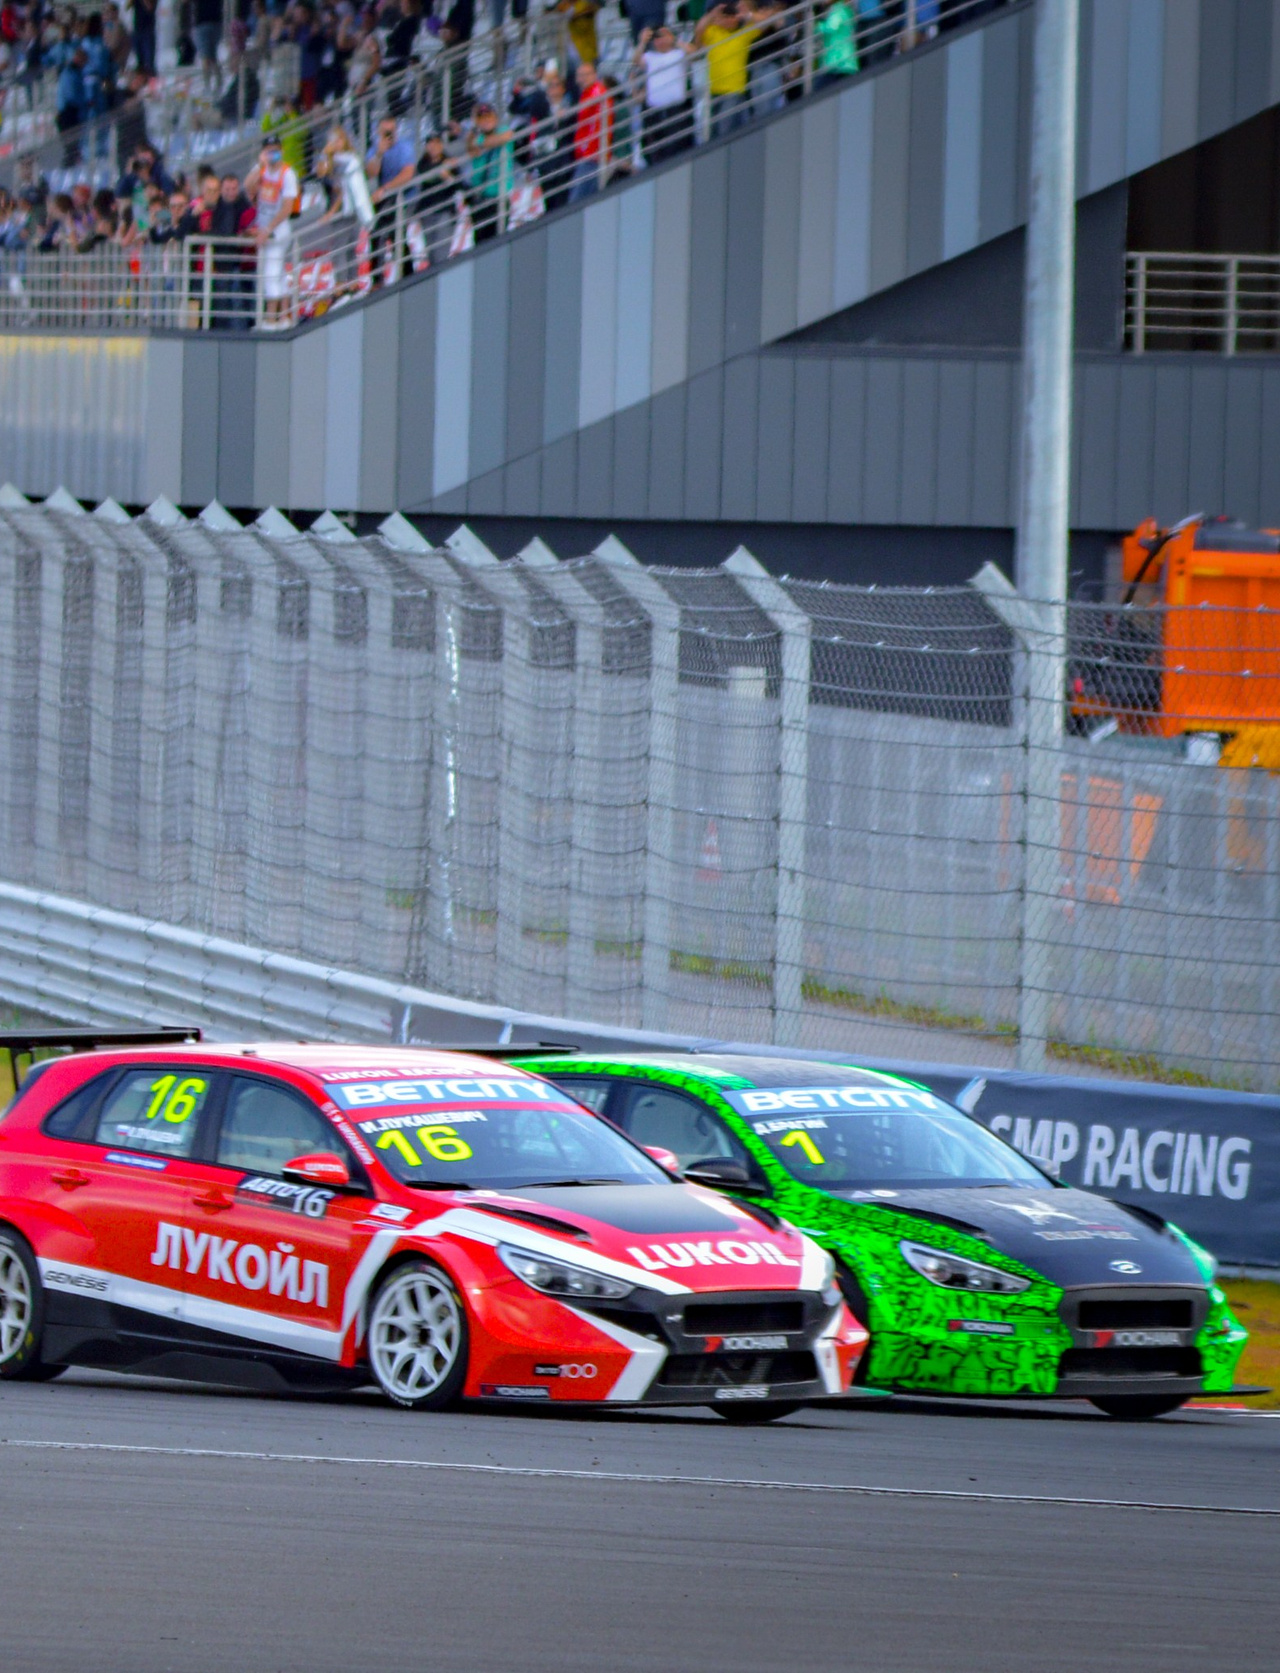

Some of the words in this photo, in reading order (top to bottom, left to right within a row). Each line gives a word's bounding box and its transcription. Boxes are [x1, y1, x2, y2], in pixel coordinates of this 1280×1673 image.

[322, 1069, 395, 1081] LUKOIL
[146, 1074, 206, 1123] 16
[341, 1078, 550, 1105] BETCITY
[740, 1089, 938, 1111] BETCITY
[376, 1125, 474, 1166] 16
[781, 1130, 826, 1165] 1
[1083, 1124, 1252, 1200] RACING
[292, 1187, 337, 1217] 16
[150, 1221, 329, 1309] ЛУКОЙЛ
[626, 1241, 801, 1270] LUKOIL
